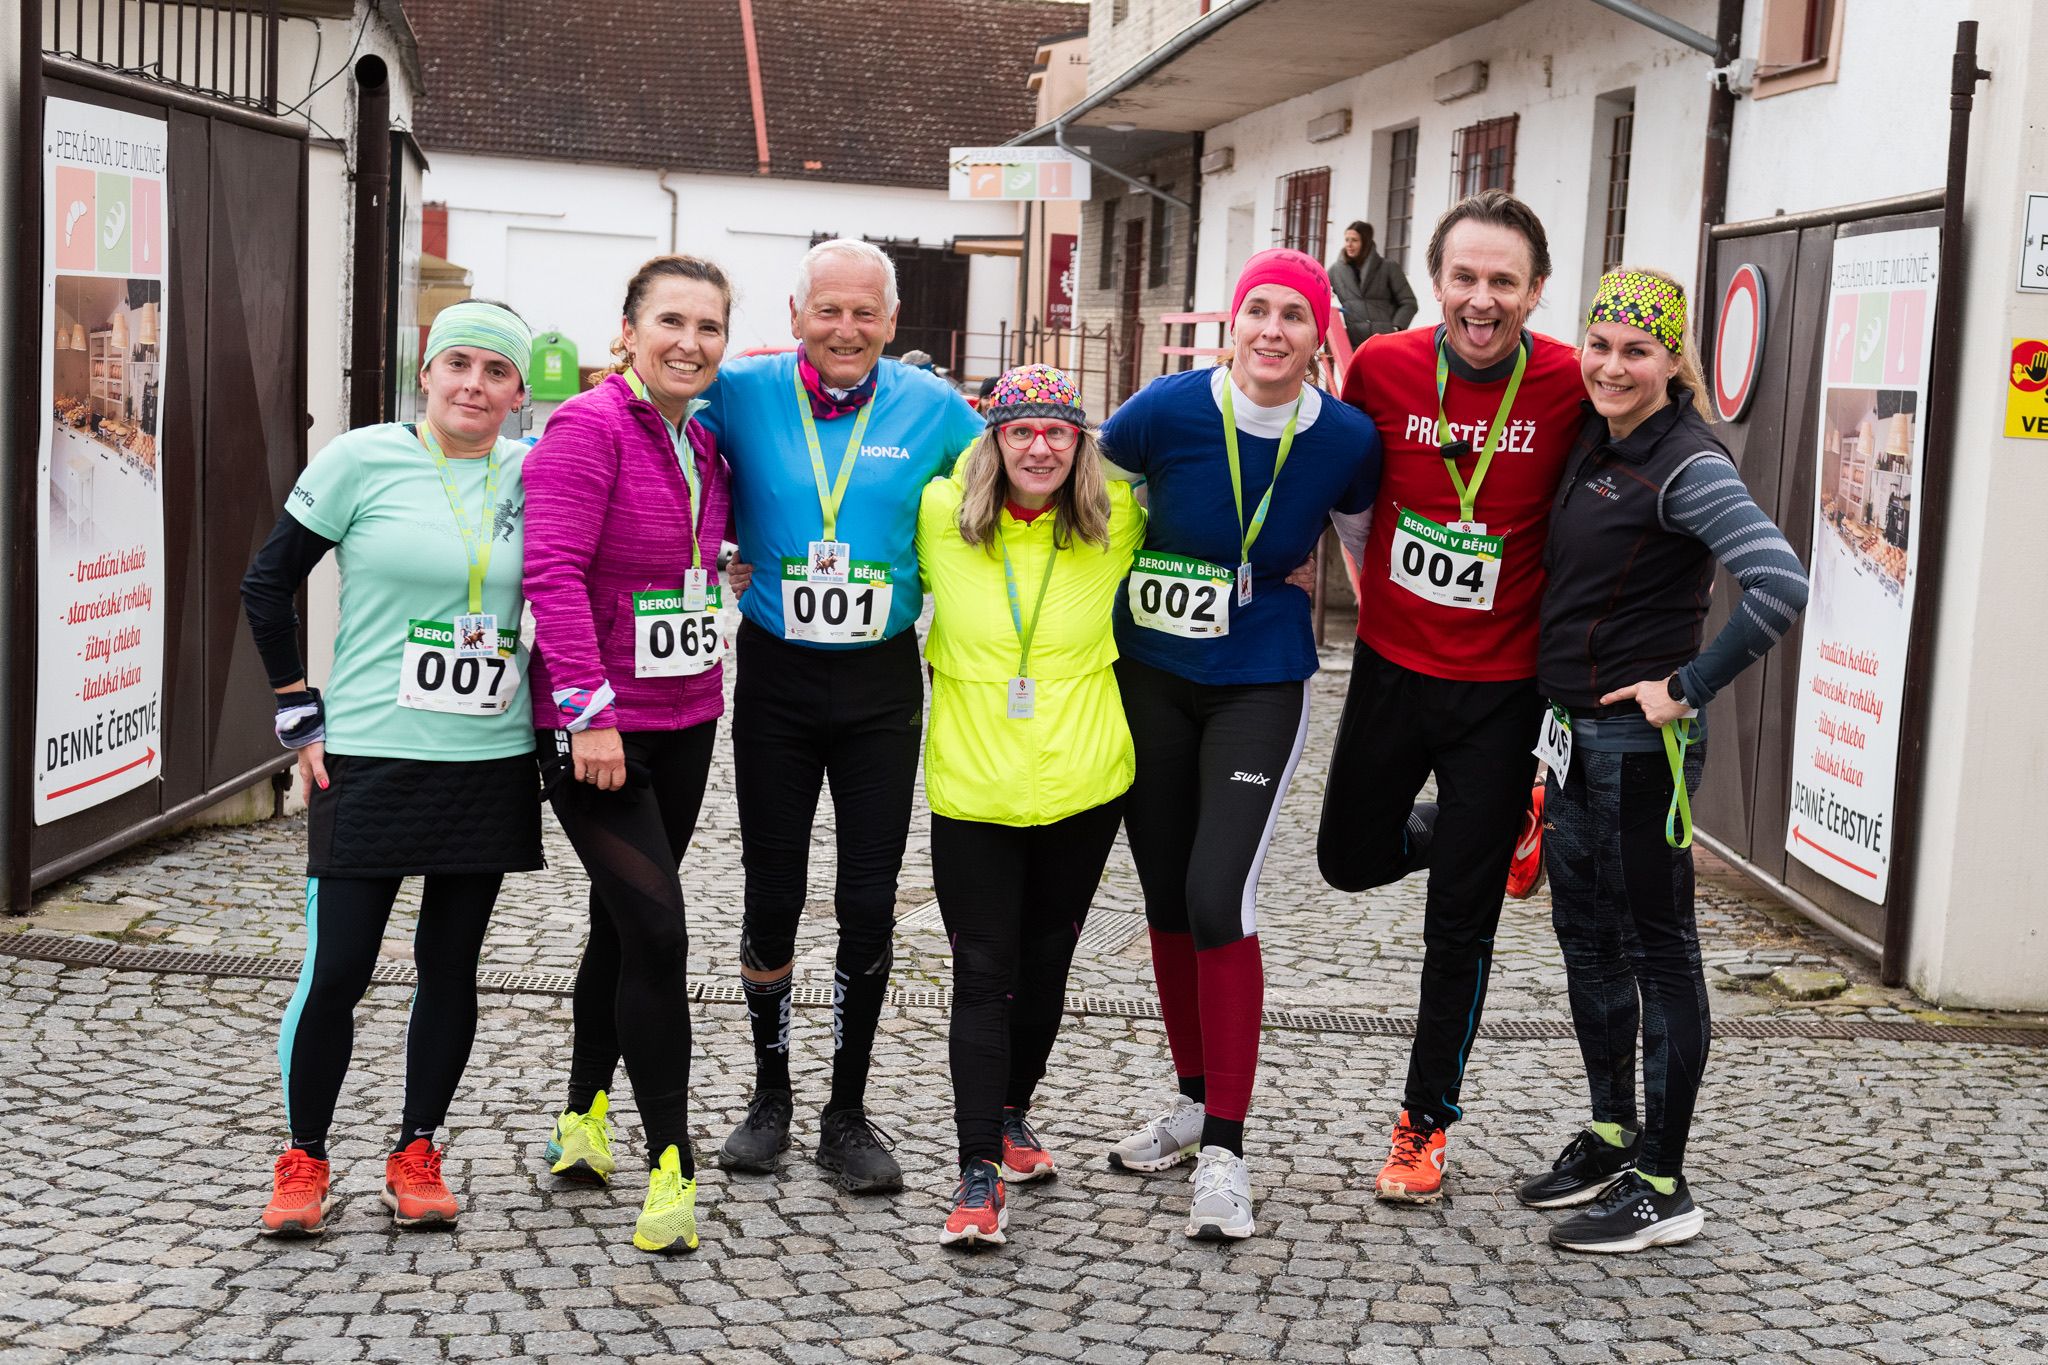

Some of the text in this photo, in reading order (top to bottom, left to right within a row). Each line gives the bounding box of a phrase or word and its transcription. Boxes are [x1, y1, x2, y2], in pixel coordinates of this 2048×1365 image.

[56, 129, 161, 174] PEKÁRNA VE MLÝNĚ
[1875, 259, 1888, 286] VE
[1889, 252, 1928, 286] MLÝNĚ
[860, 445, 910, 460] HONZA
[1402, 516, 1497, 554] BEROUN V BĚHU
[78, 548, 119, 583] tradiční
[121, 544, 146, 574] koláče
[854, 565, 886, 580] BĚHU
[1138, 556, 1229, 579] BEROUN V BĚHU
[1402, 541, 1484, 593] 004
[67, 588, 122, 625] staročeské
[123, 581, 152, 613] rohlíky
[793, 586, 874, 626] 001
[1140, 579, 1217, 622] 002
[85, 635, 111, 664] žitný
[113, 625, 141, 652] chleba
[414, 627, 452, 642] BERO
[649, 615, 718, 659] 065
[416, 651, 506, 697] 007
[1820, 638, 1848, 668] tradiční
[1848, 650, 1879, 677] koláče
[83, 672, 119, 702] italská
[120, 663, 142, 691] káva
[1812, 672, 1848, 705] staročeské
[1848, 687, 1883, 725] rohlíky
[47, 691, 157, 772] DENNĚ ČERSTVÉ
[1819, 710, 1837, 744] žitný
[1838, 722, 1865, 750] chleba
[1814, 746, 1840, 777] italská
[1841, 757, 1864, 788] káva
[1795, 780, 1883, 853] DENNĚ ČERSTVÉ
